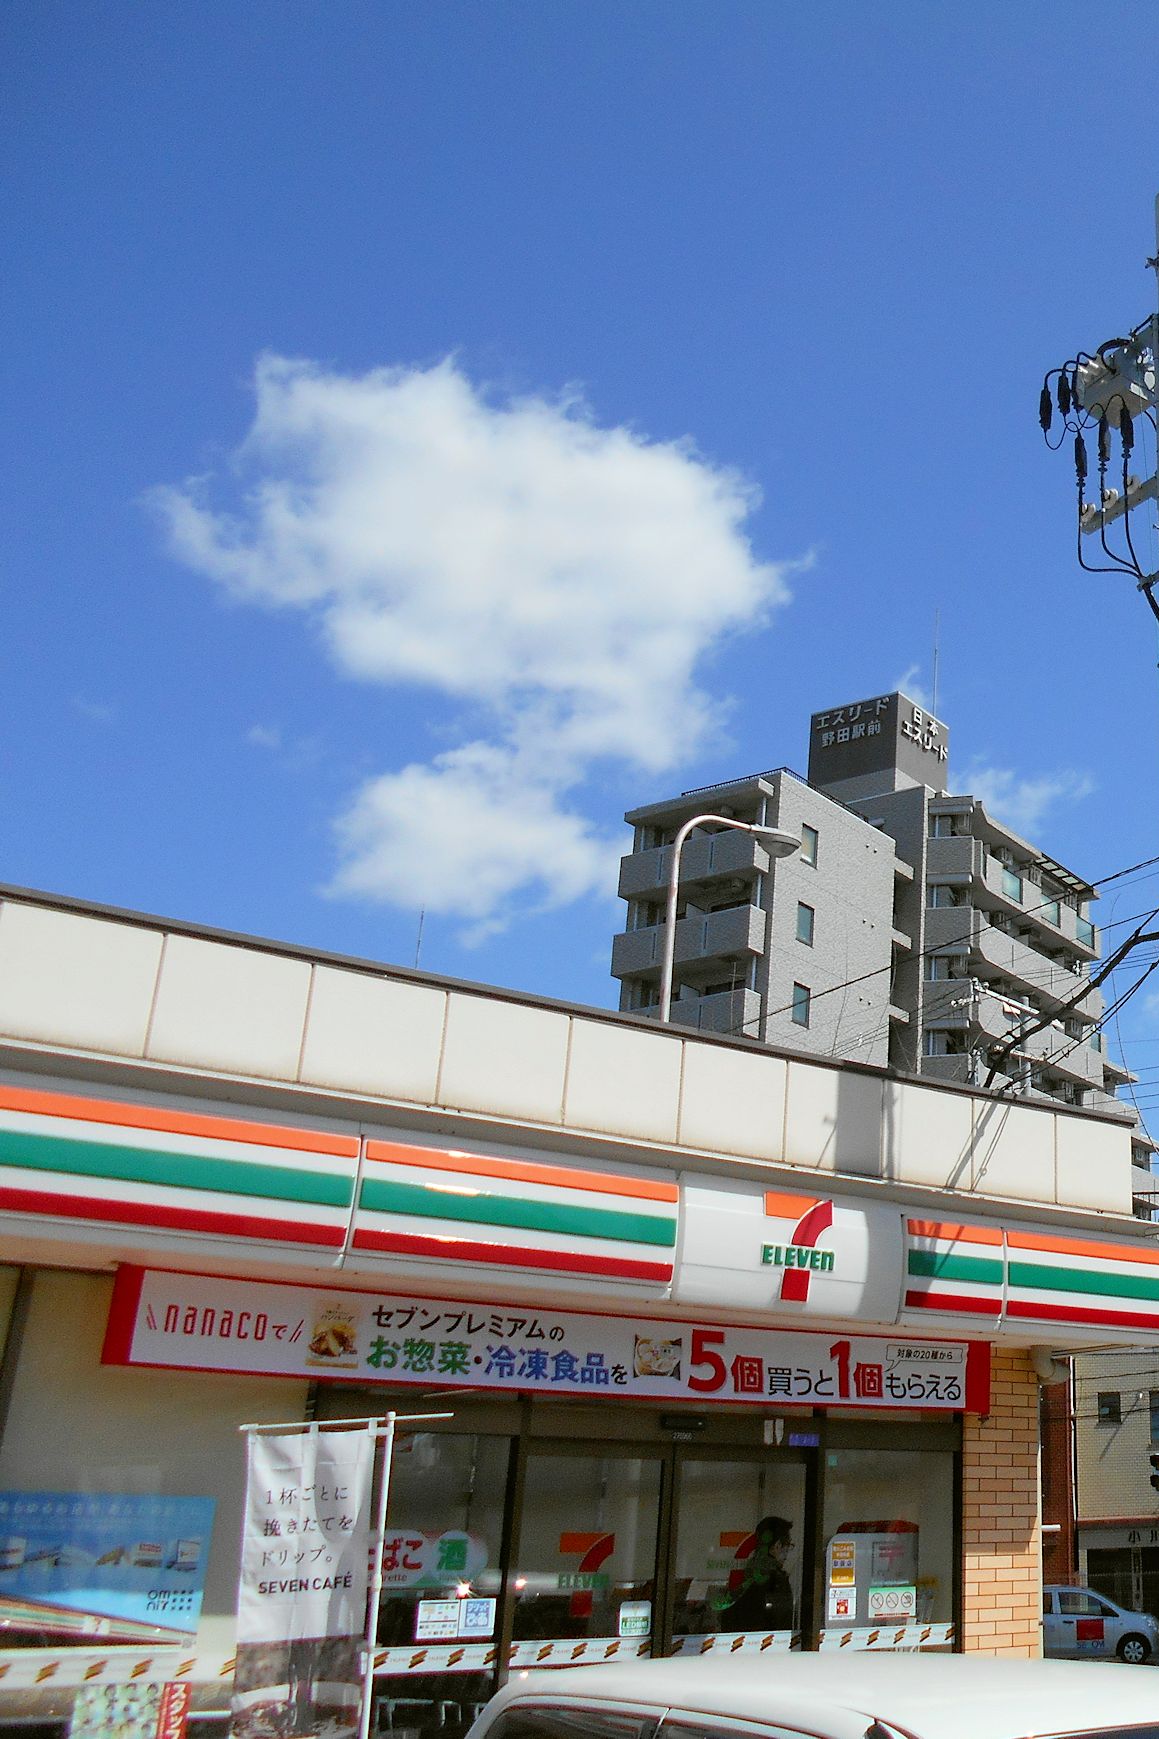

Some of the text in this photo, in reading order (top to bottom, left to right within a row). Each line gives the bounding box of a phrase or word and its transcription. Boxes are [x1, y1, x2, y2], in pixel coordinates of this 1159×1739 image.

[816, 697, 889, 730] エスリード
[912, 707, 940, 737] 日本
[821, 720, 881, 748] 野田駅前
[902, 720, 949, 760] エスリード
[372, 1305, 565, 1341] セブンプレミアムの
[366, 1335, 628, 1385] お惣菜・冷凍食品を
[266, 1484, 348, 1505] 1杯ごとに
[263, 1515, 353, 1537] 挽きたてを
[258, 1571, 353, 1594] SEVEN CAFÉ
